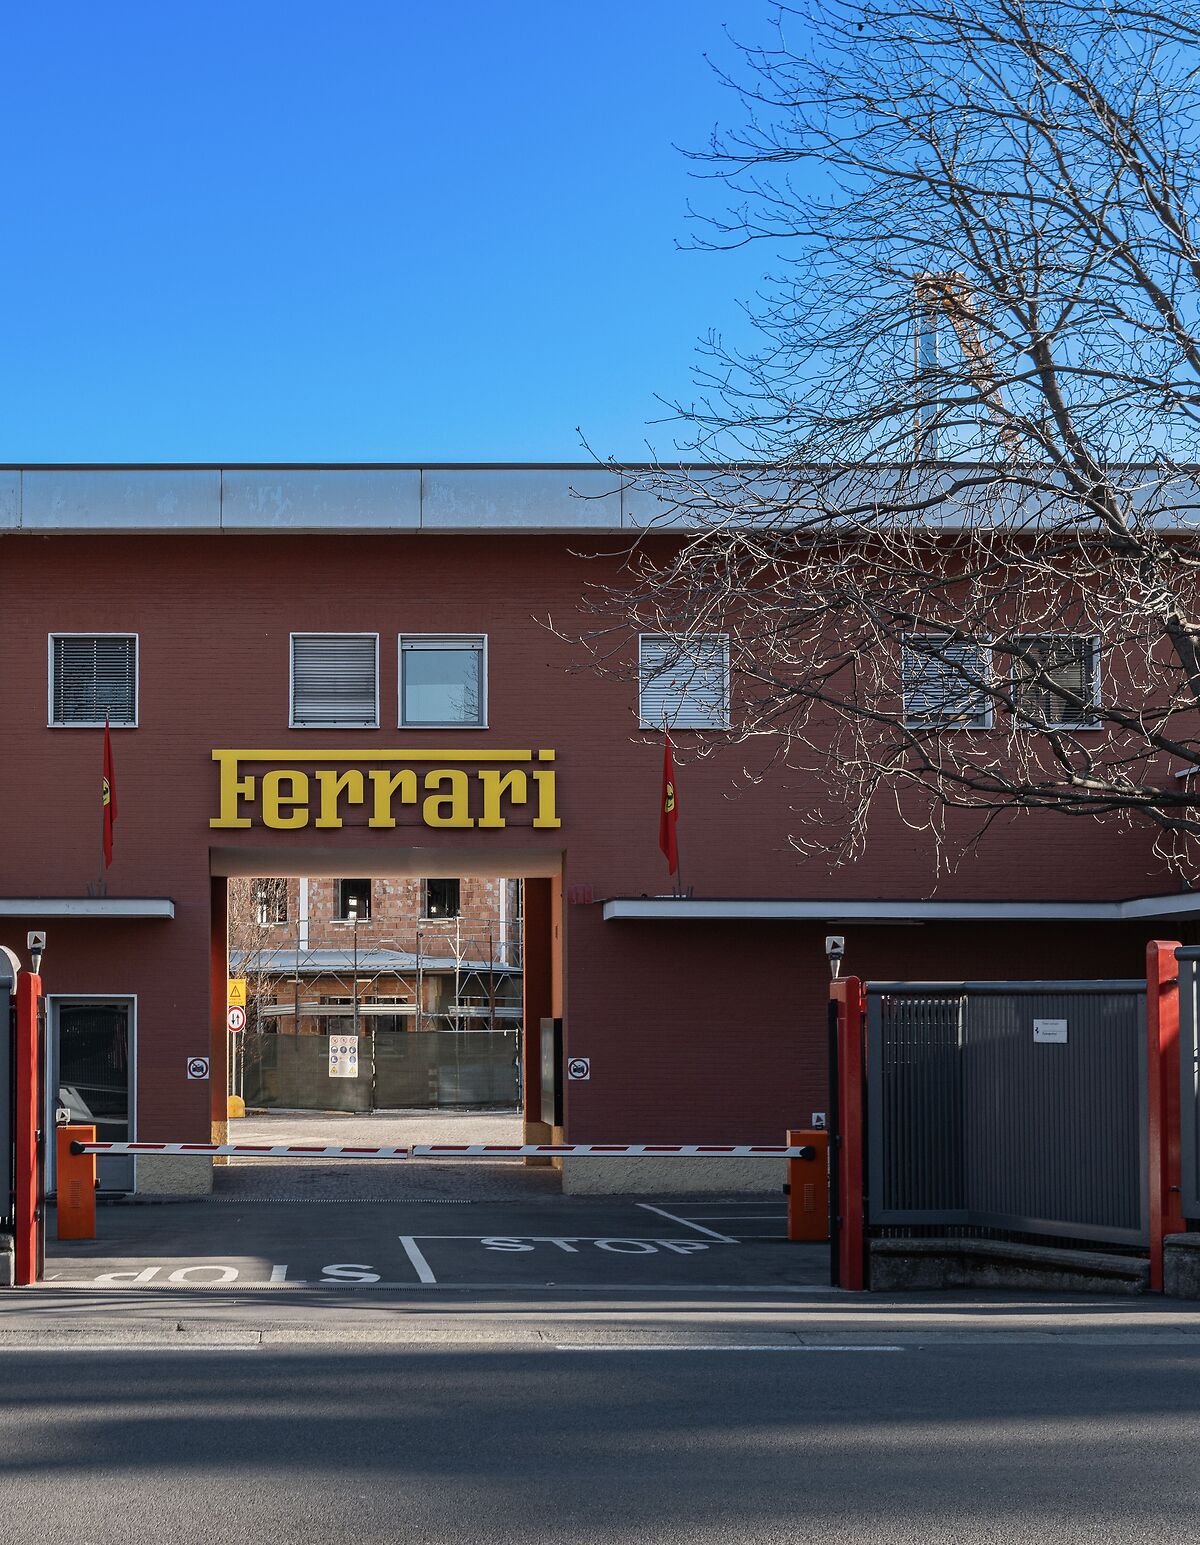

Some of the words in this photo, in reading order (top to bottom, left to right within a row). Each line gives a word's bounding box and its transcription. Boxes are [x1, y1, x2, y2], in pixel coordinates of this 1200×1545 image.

[209, 749, 561, 829] Ferrari
[480, 1237, 710, 1254] STOP
[94, 1263, 381, 1283] STOP
